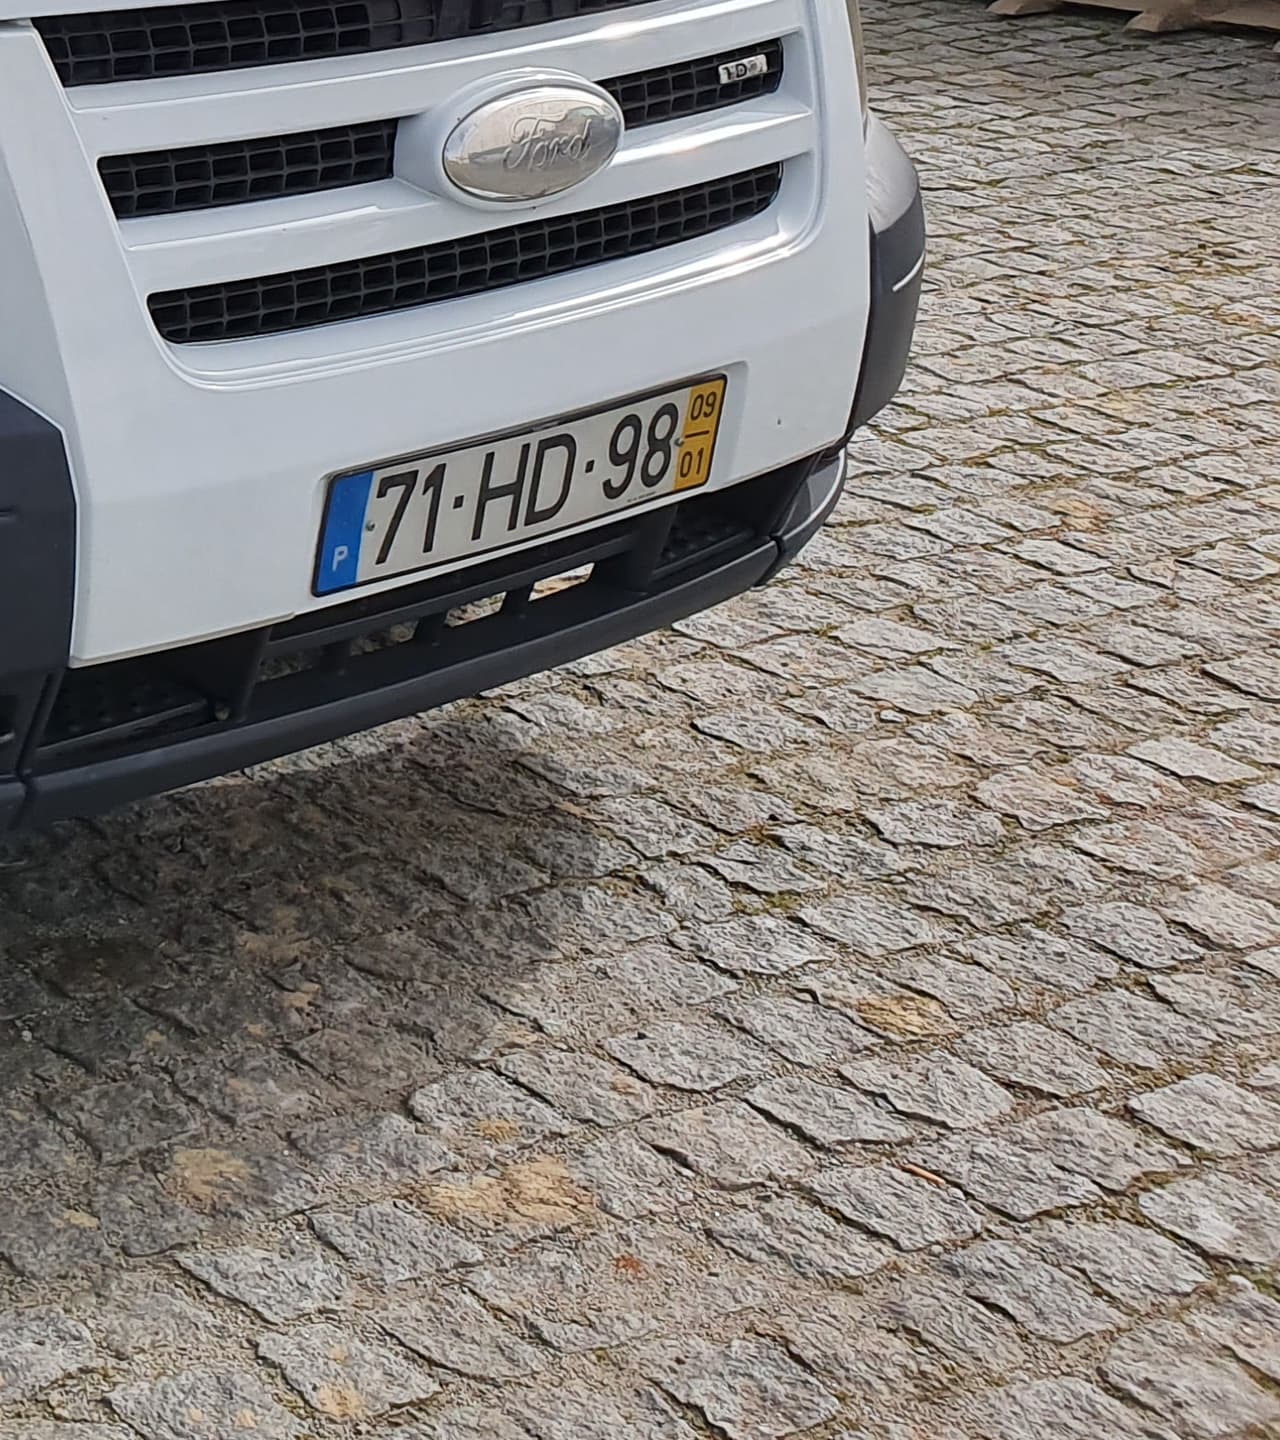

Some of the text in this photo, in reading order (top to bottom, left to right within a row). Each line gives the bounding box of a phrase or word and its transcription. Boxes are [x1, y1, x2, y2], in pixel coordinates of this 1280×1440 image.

[502, 115, 593, 172] Ford
[690, 391, 717, 421] 09
[679, 447, 704, 479] 01
[331, 546, 349, 572] P
